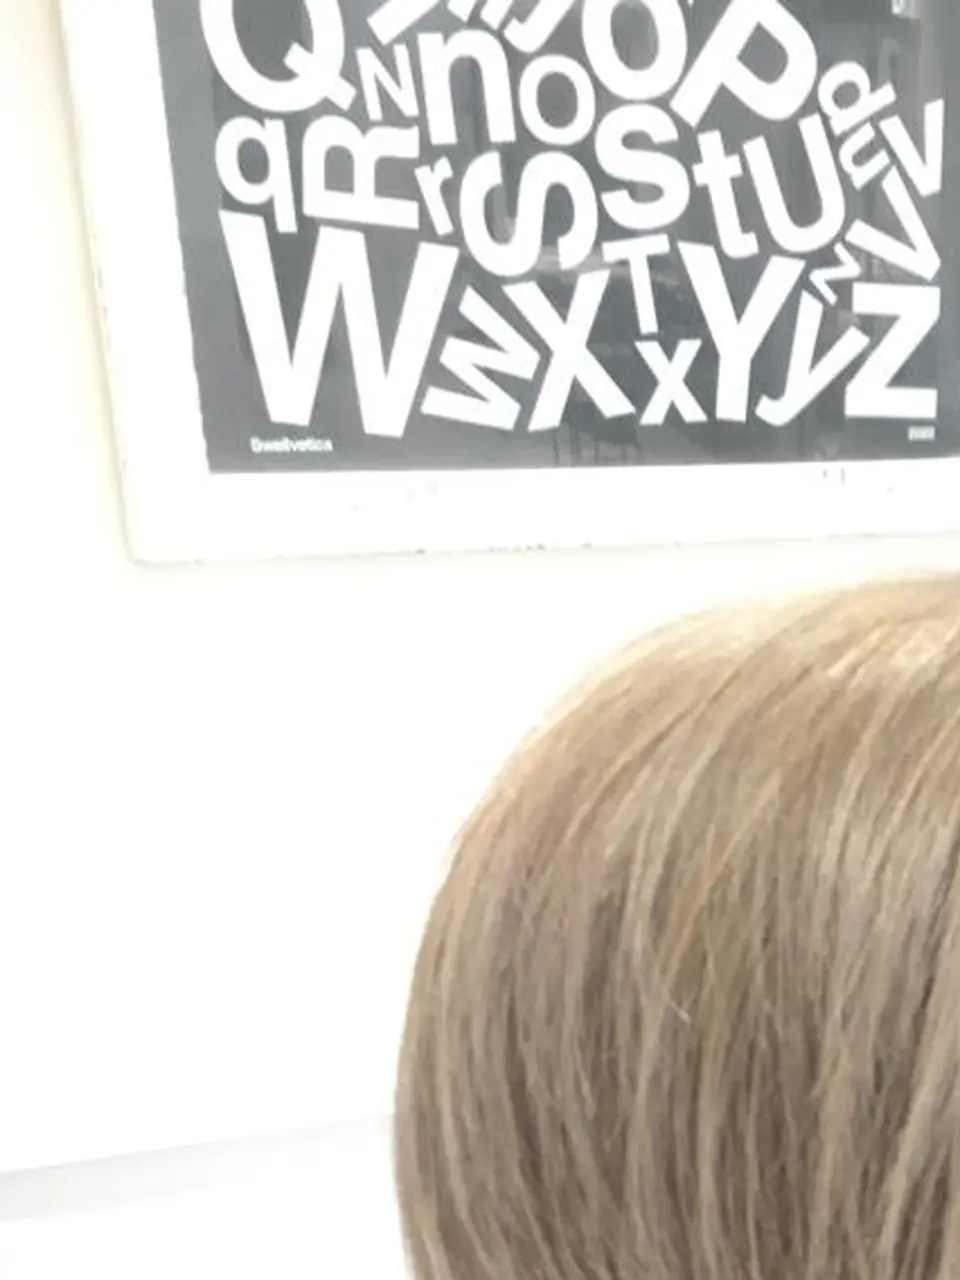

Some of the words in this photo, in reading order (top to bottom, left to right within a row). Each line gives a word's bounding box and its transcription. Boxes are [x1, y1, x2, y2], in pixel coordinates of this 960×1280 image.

[201, 0, 357, 112] Q
[417, 29, 516, 145] n
[670, 0, 817, 128] P
[215, 117, 298, 233] q
[302, 115, 420, 229] R
[218, 209, 460, 438] W
[602, 234, 670, 334] T
[678, 241, 806, 422] Y
[845, 282, 941, 419] Z
